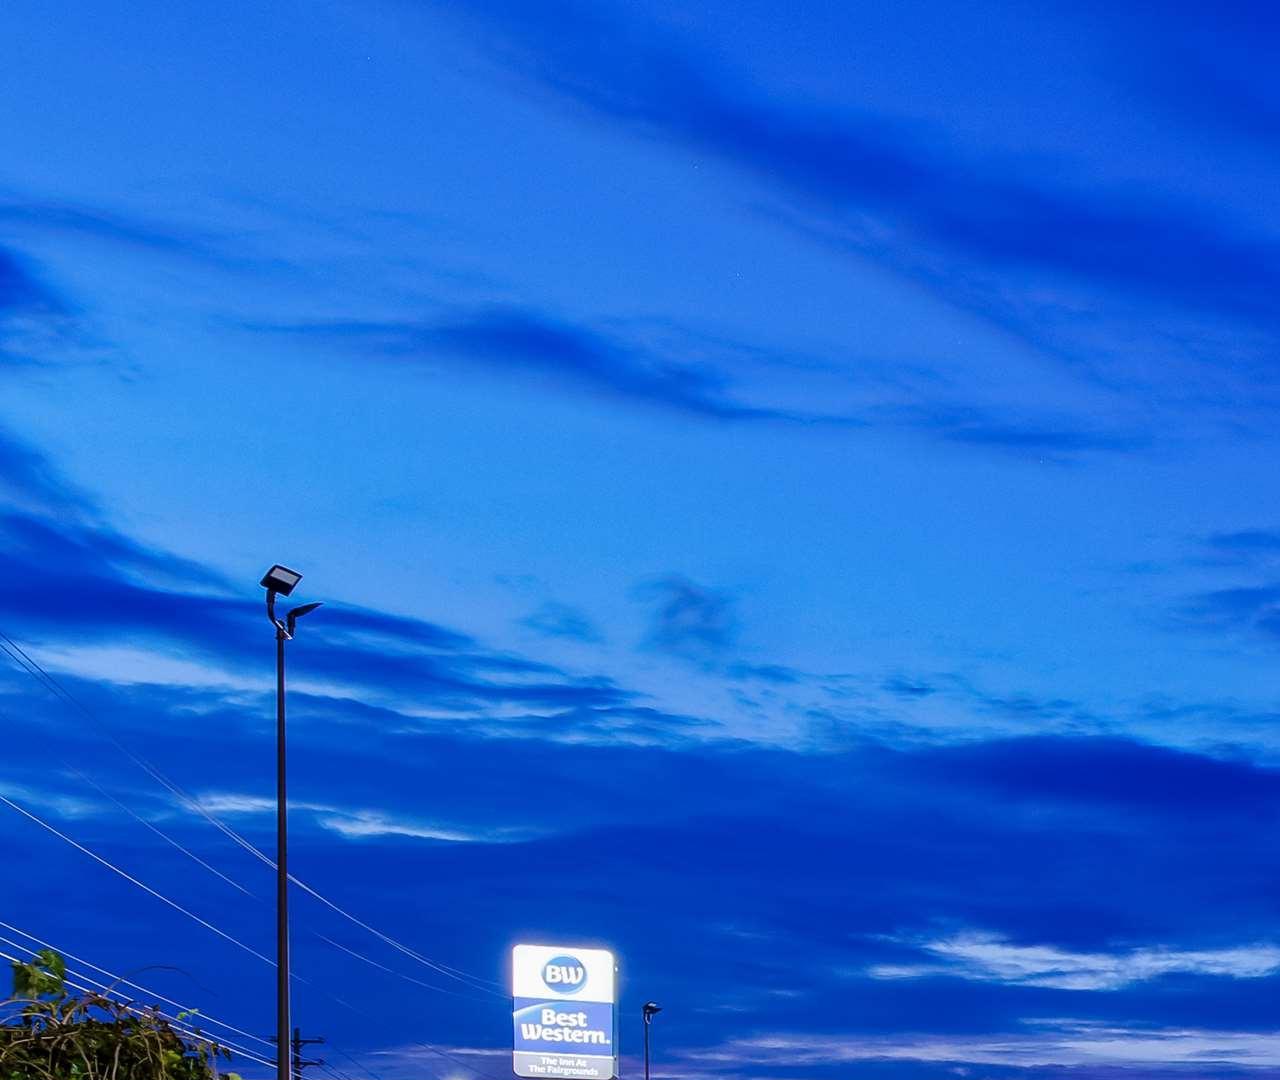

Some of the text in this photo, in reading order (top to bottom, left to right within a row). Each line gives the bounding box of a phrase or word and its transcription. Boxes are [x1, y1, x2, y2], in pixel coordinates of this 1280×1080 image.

[546, 965, 583, 984] BW
[541, 1009, 587, 1026] Best
[541, 1057, 557, 1065] The
[559, 1058, 574, 1066] Inn
[528, 1064, 598, 1076] The Fairgrounds
